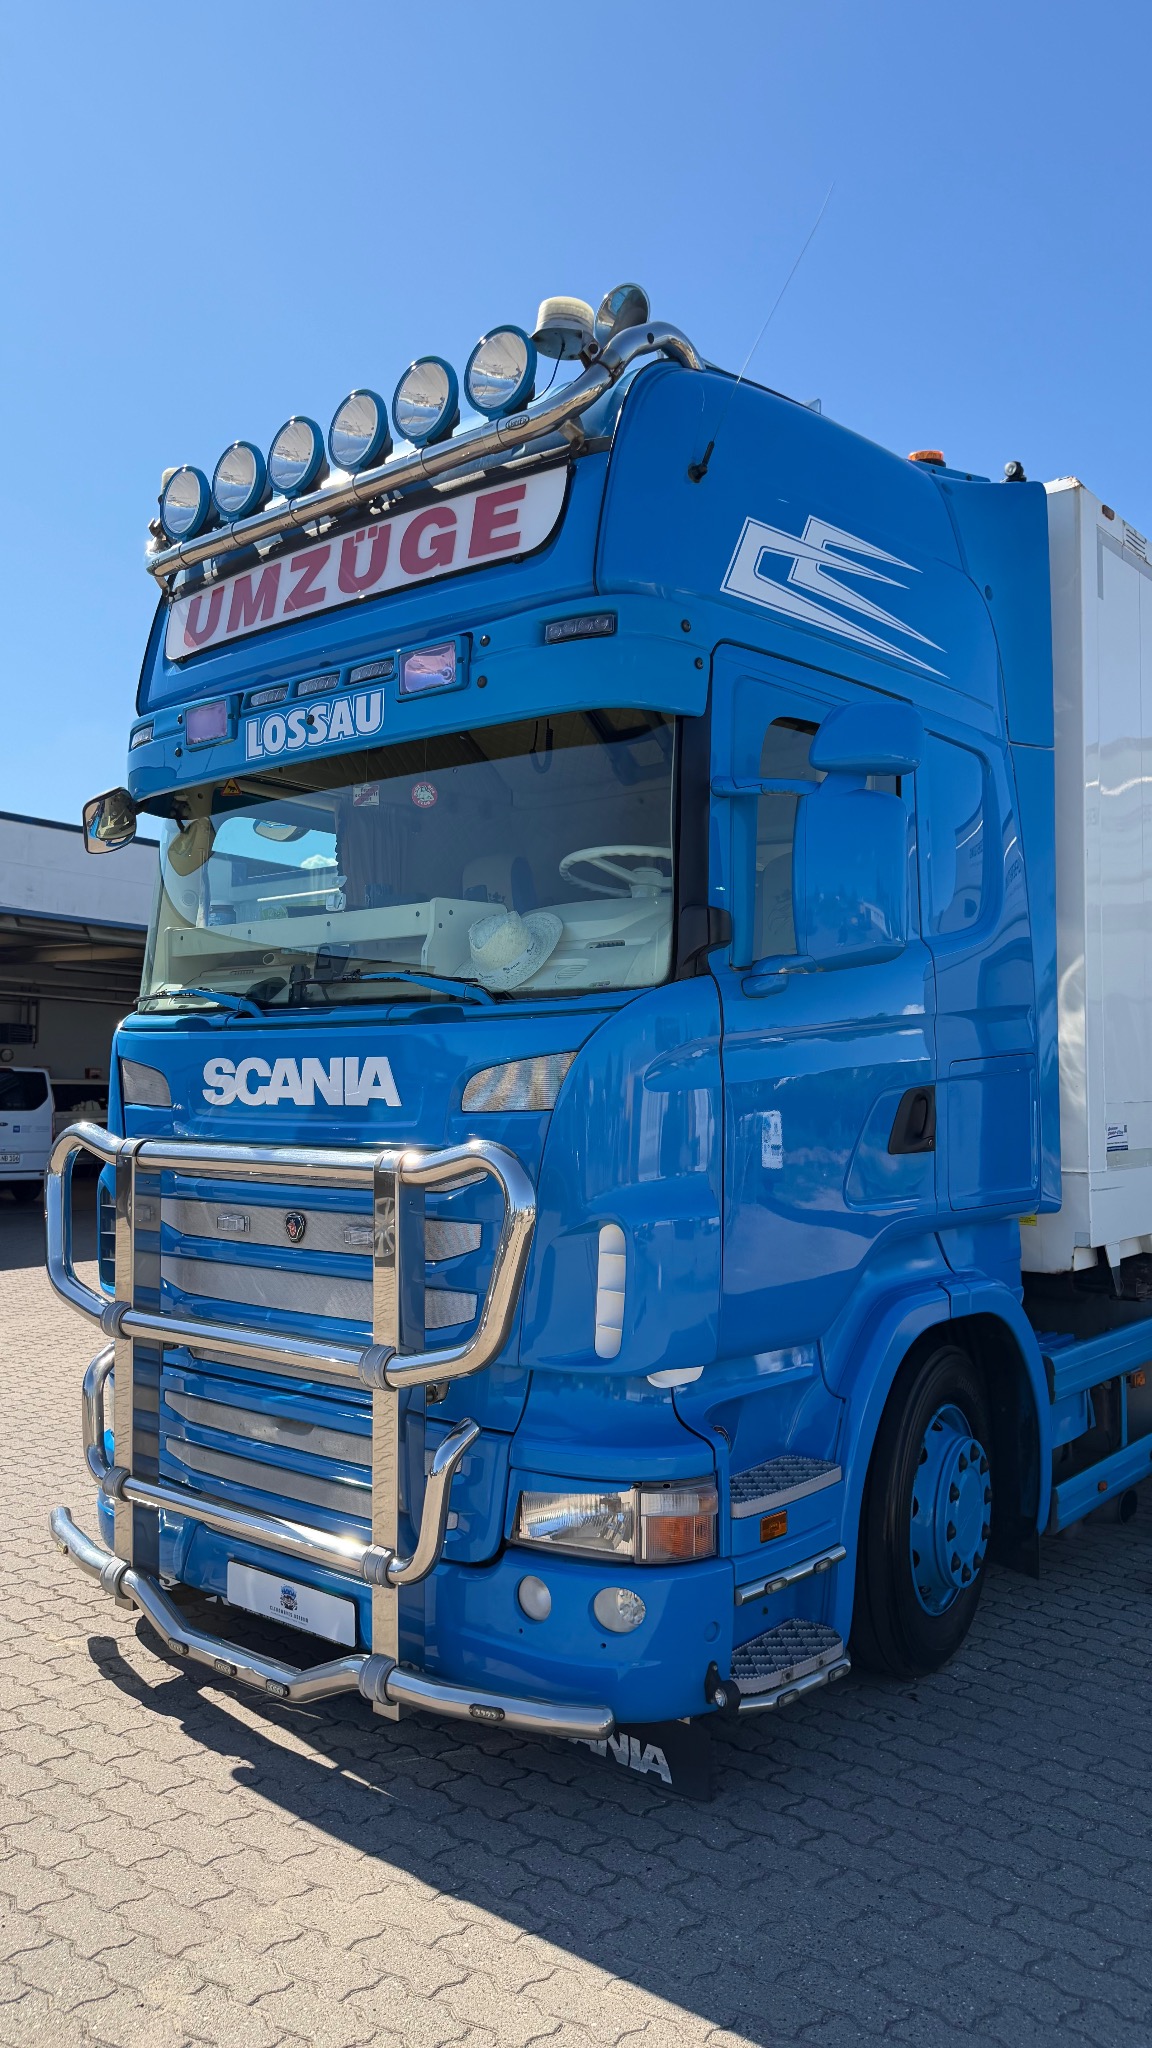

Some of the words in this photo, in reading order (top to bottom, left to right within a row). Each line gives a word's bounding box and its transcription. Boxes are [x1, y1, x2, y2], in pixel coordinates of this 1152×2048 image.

[183, 483, 527, 649] UMZÜGE
[246, 688, 385, 761] LOSSAU
[202, 1056, 403, 1107] SCANIA
